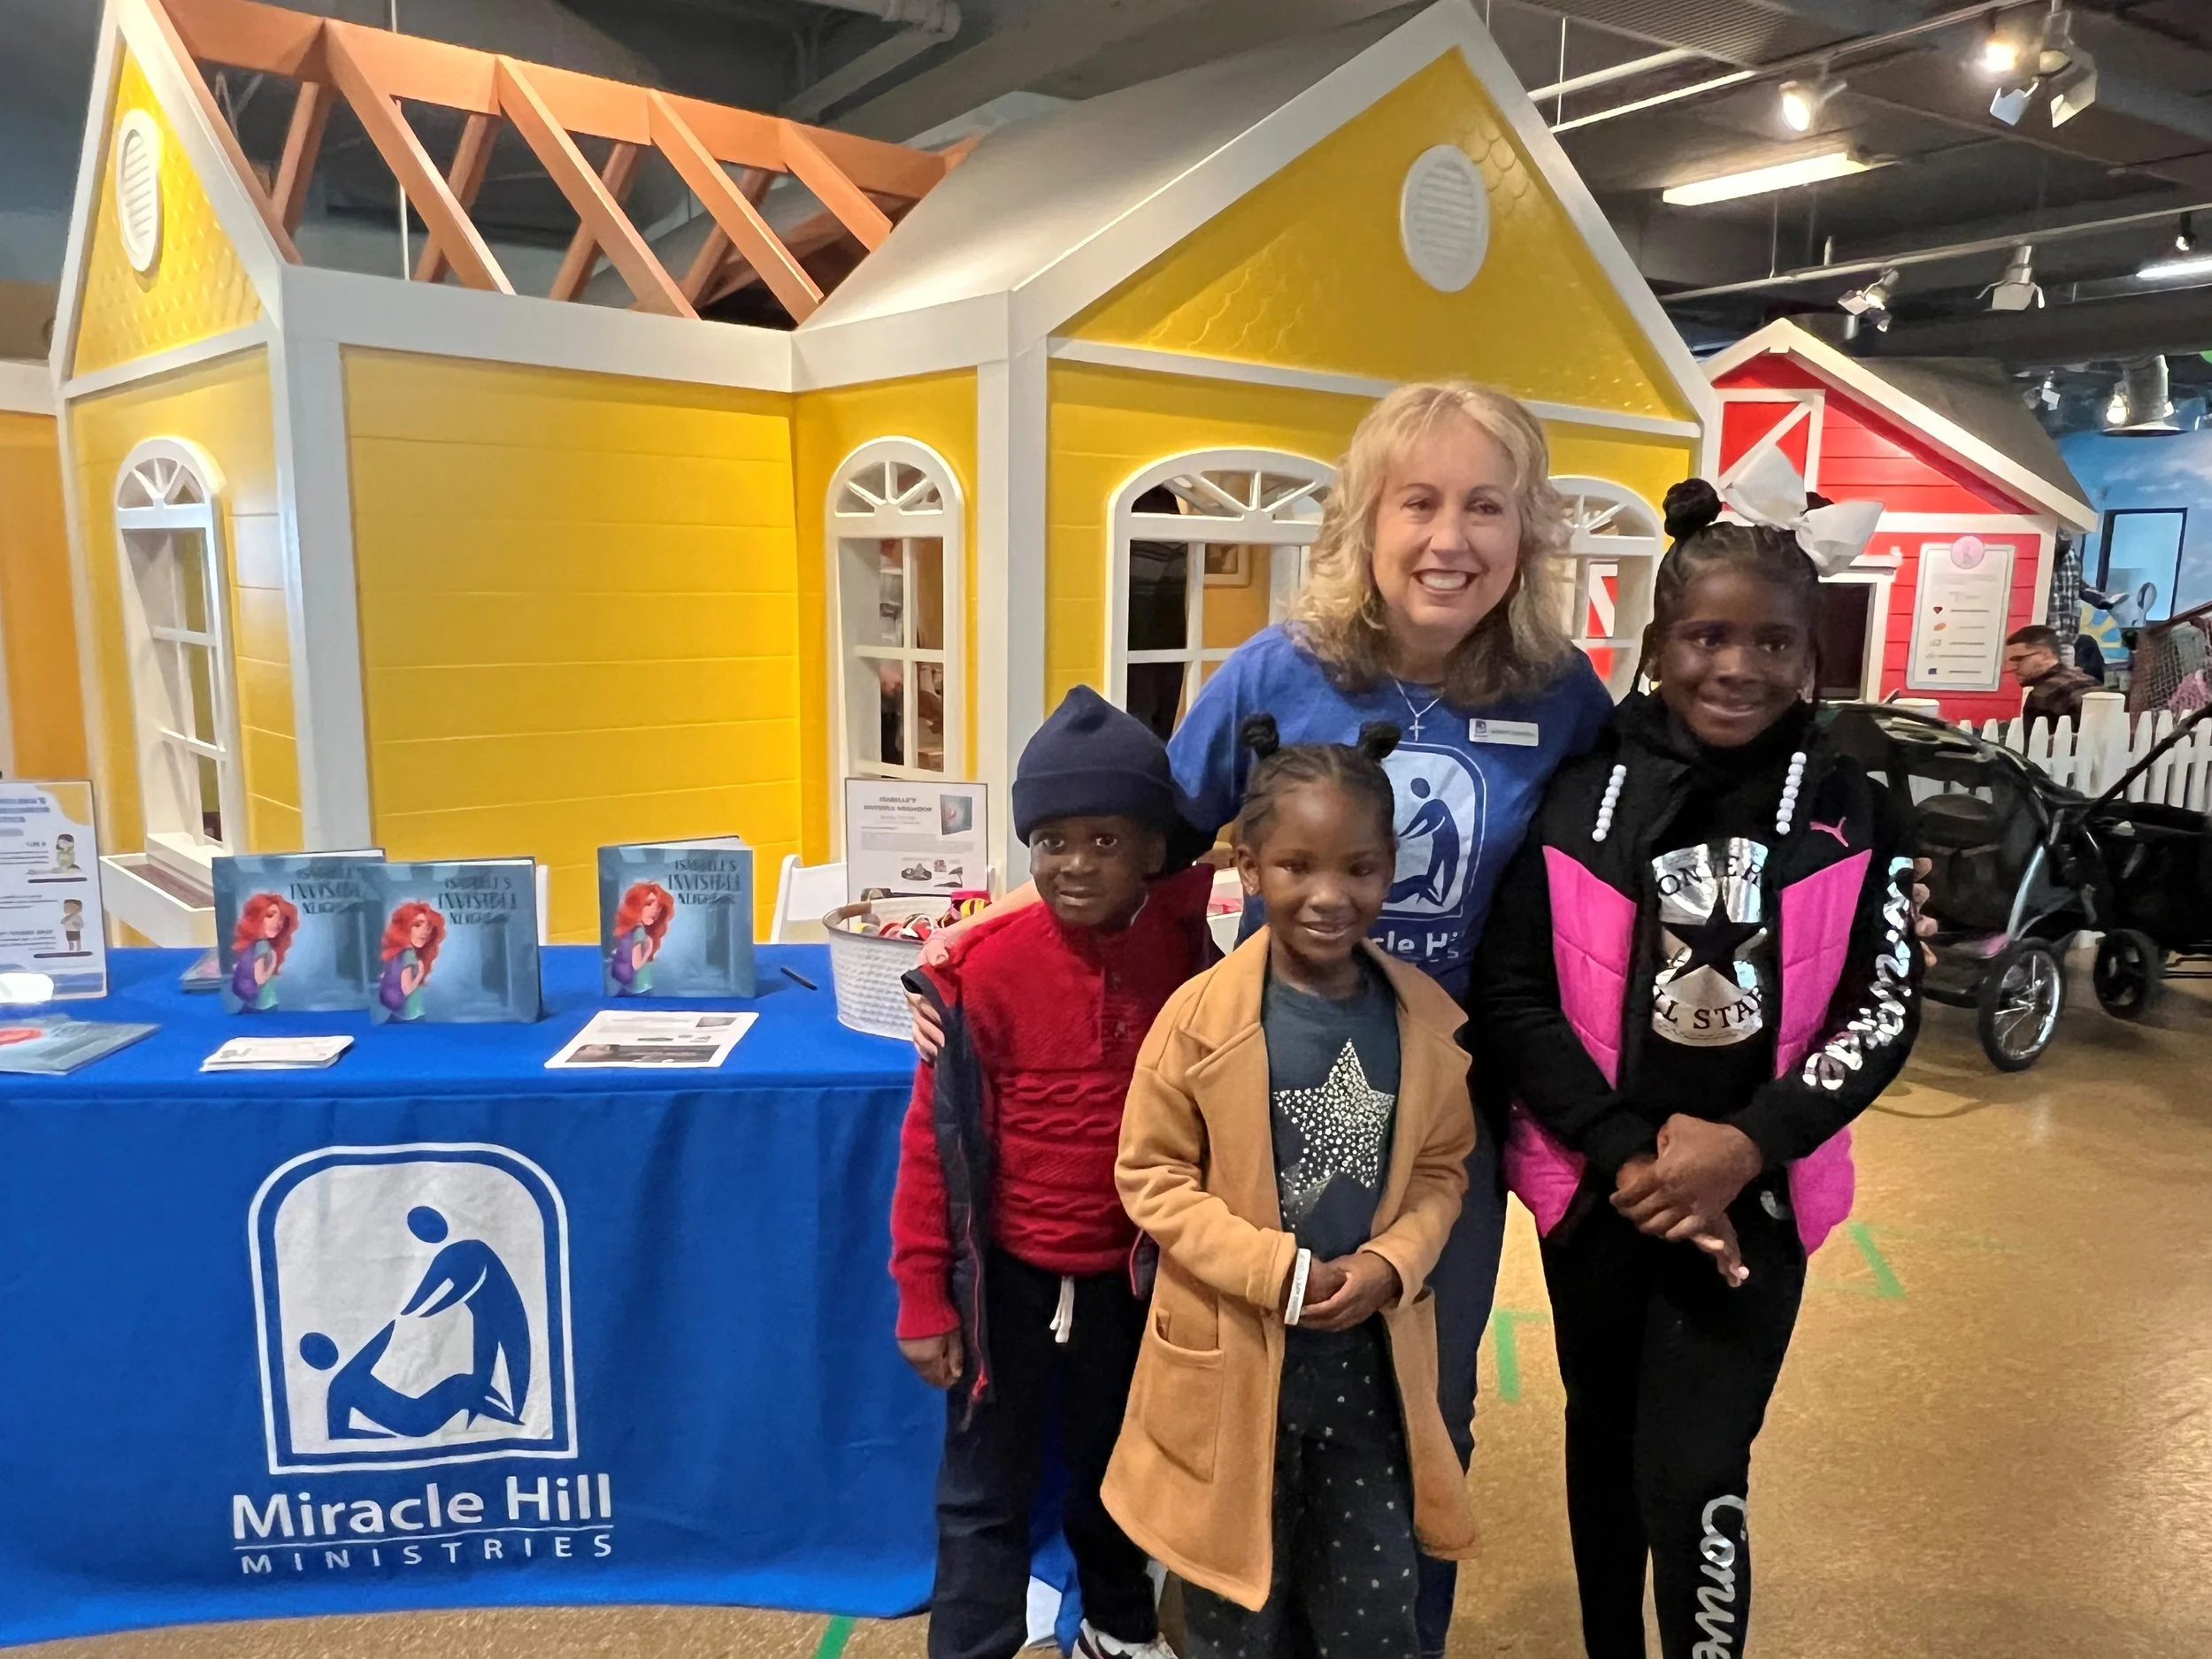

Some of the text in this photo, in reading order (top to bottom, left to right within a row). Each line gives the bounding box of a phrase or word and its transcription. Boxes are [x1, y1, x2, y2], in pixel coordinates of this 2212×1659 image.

[233, 1473, 611, 1540] Miracle Hill
[241, 1533, 612, 1575] MINISTRIES
[1692, 1494, 1747, 1659] Conve
